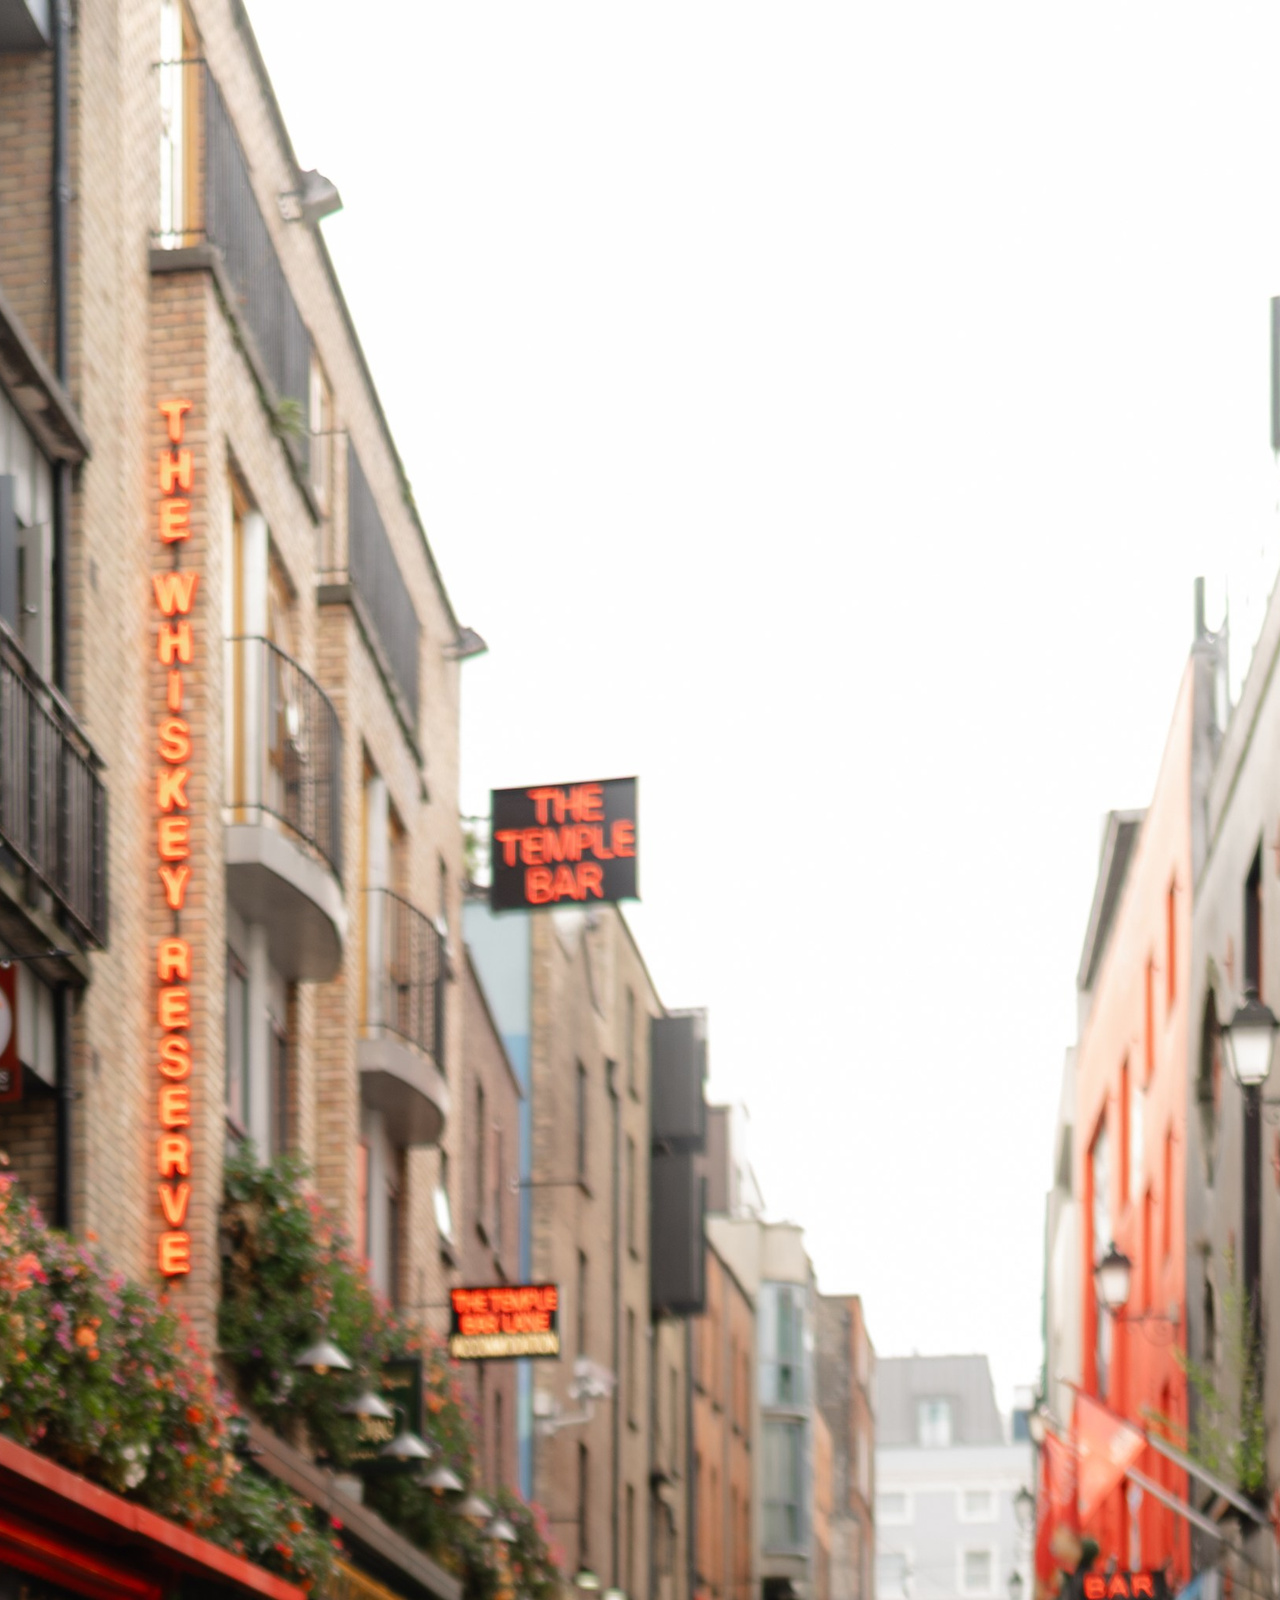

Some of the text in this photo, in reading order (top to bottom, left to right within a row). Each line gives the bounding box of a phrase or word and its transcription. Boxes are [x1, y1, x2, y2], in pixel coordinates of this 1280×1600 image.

[526, 783, 605, 826] THE
[152, 400, 200, 1276] THE WHISKEY RESERVE
[494, 819, 636, 867] TEMPLE
[524, 861, 604, 905] BAR
[1084, 1570, 1154, 1600] BAR
